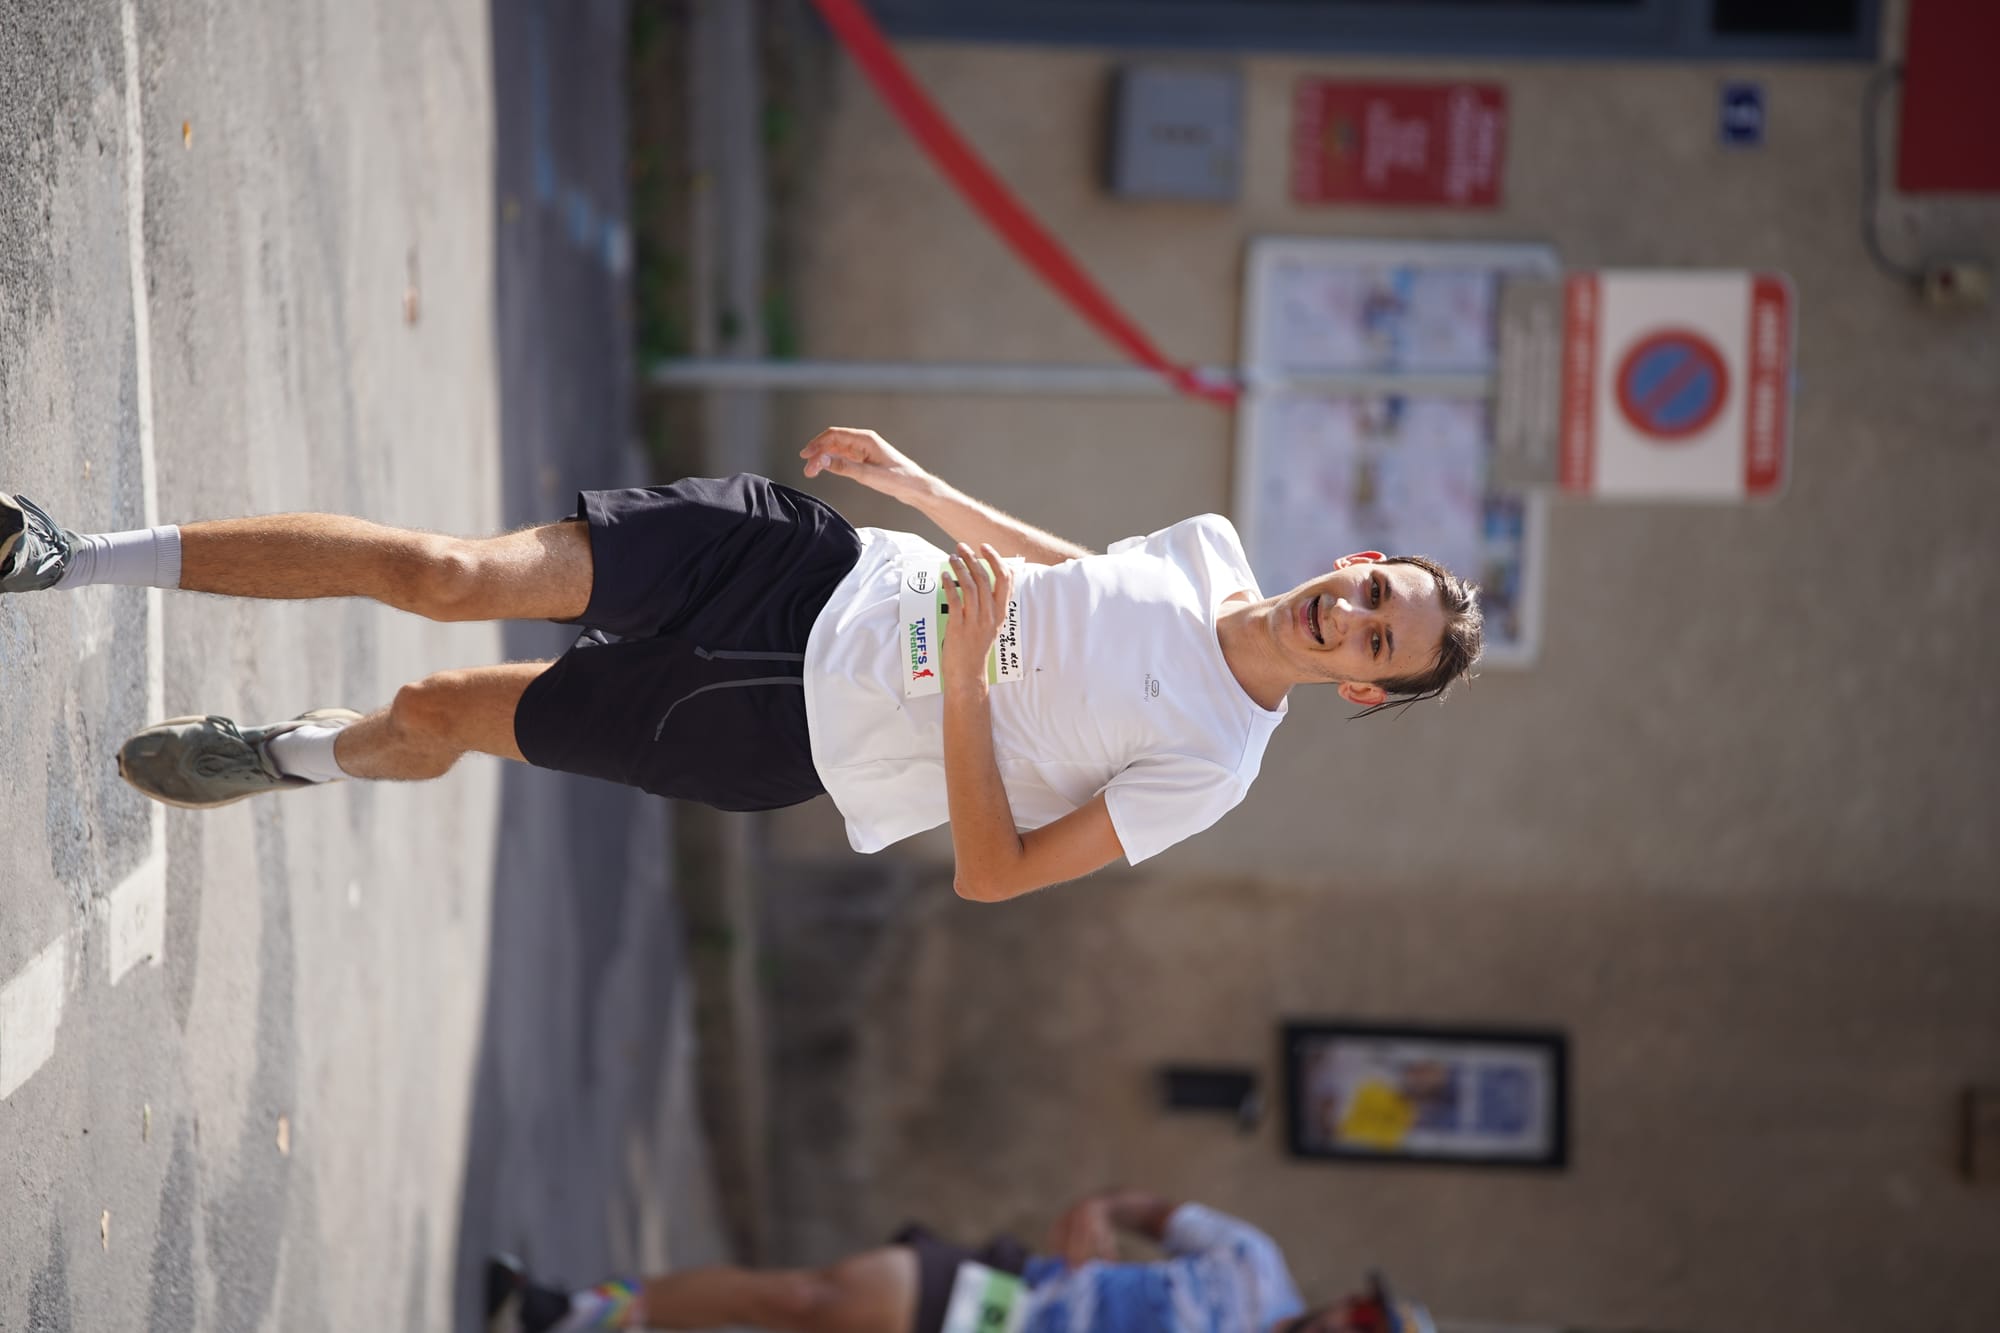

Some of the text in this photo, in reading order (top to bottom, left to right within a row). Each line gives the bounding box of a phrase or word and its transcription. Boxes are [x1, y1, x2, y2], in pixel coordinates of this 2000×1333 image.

[909, 623, 919, 671] Aventure
[916, 617, 928, 665] TUFF'S
[1006, 600, 1019, 669] Challenge des
